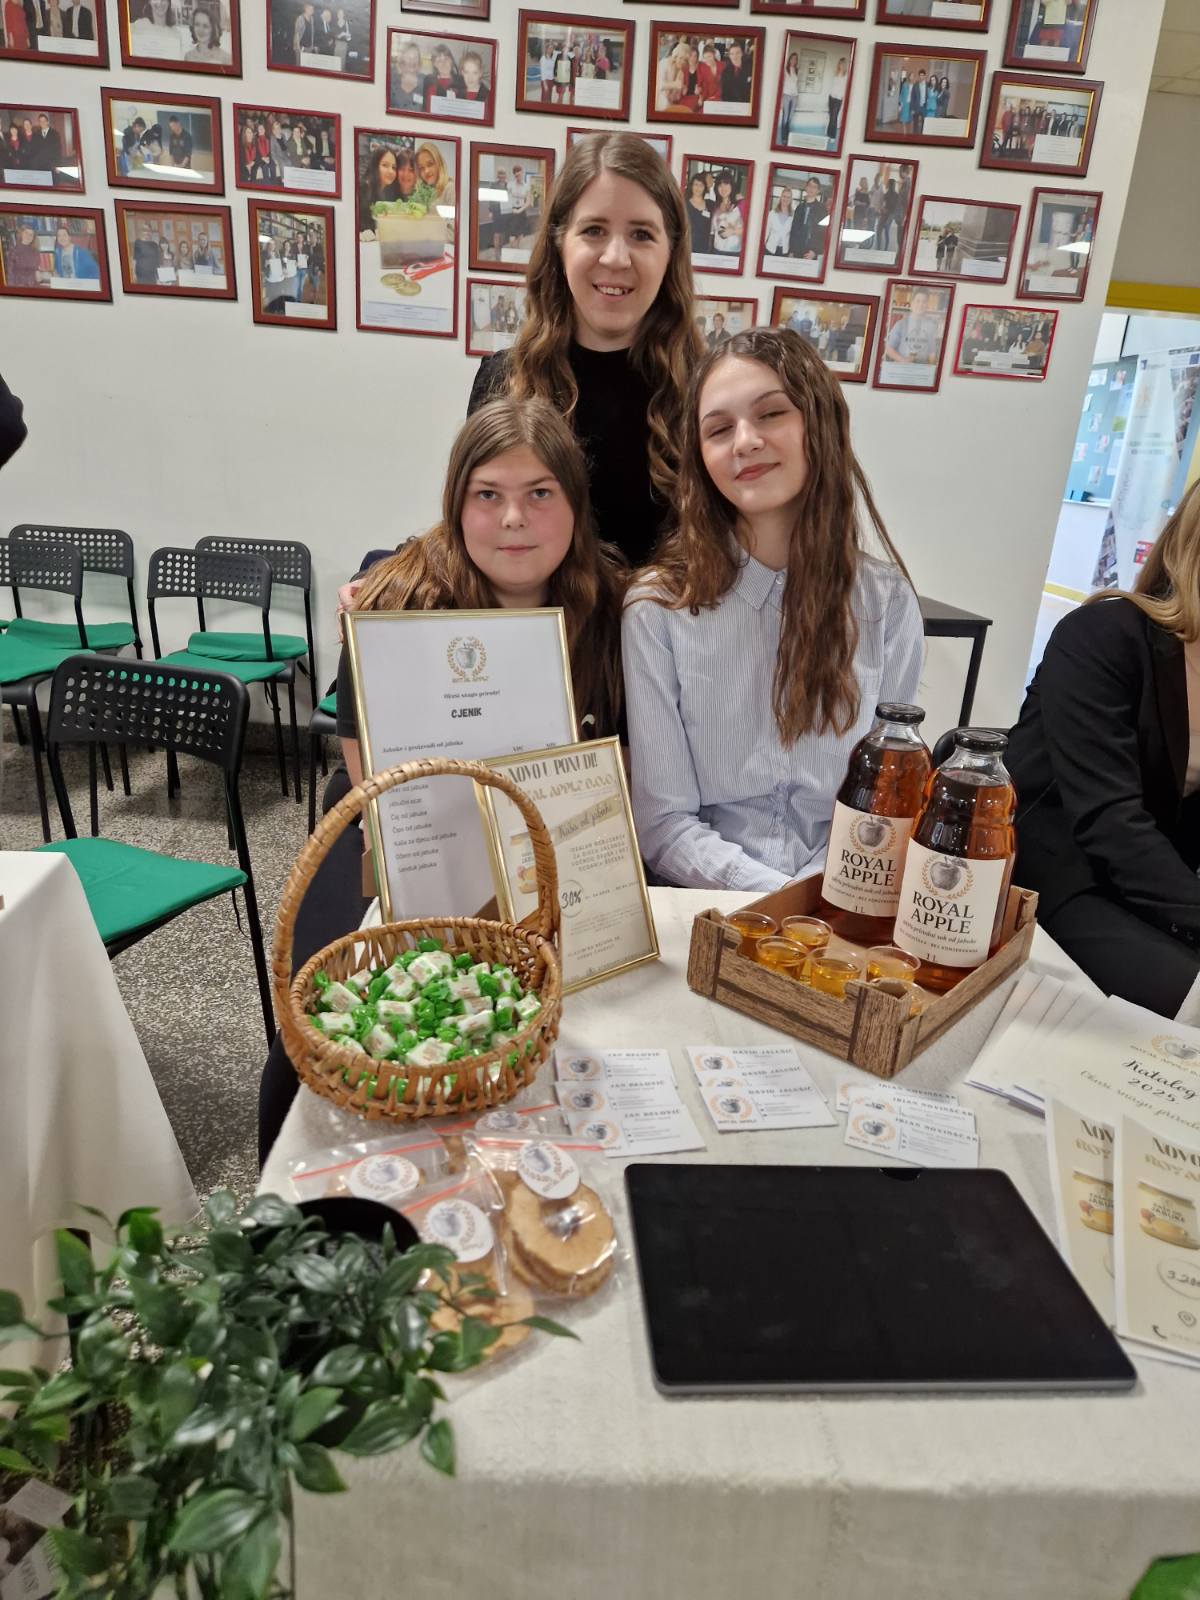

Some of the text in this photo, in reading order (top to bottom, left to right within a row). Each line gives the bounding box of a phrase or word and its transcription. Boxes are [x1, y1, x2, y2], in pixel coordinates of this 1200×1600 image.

[451, 707, 482, 718] CJENIK
[508, 763, 541, 783] NOVO
[841, 848, 897, 872] ROYAL
[839, 865, 895, 886] APPLE
[561, 889, 582, 909] 30%
[913, 891, 974, 919] ROYAL
[911, 908, 971, 934] APPLE
[1121, 1060, 1197, 1101] Katalog
